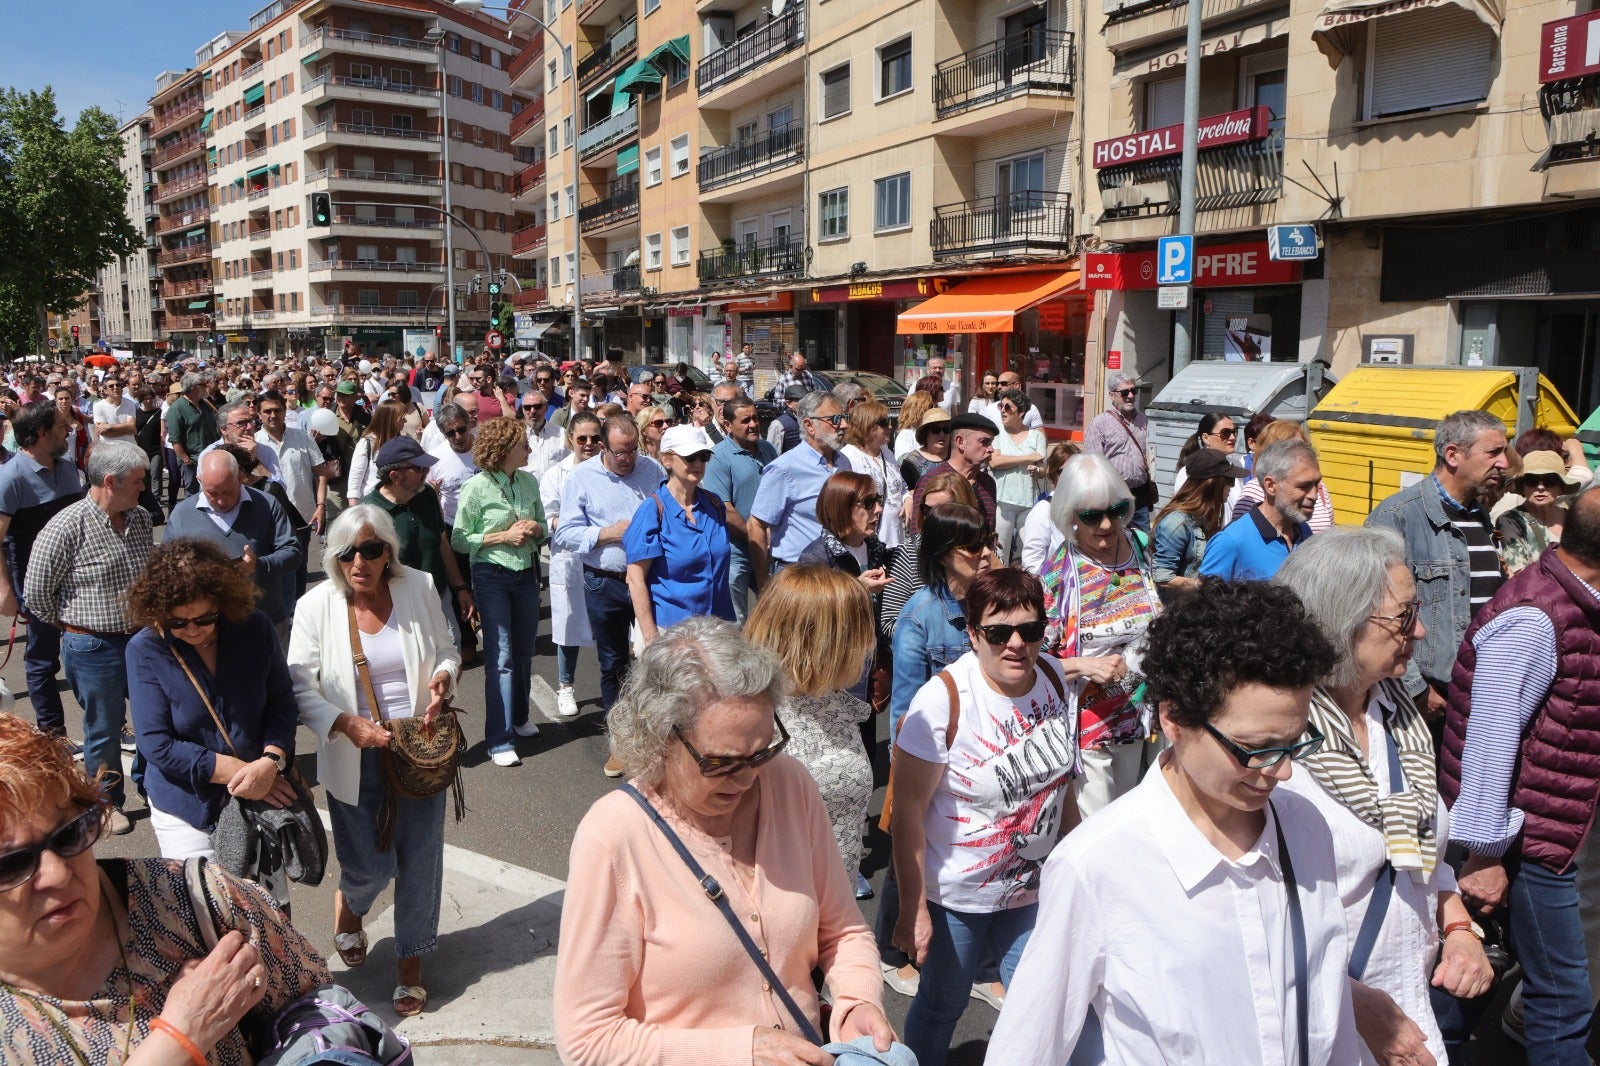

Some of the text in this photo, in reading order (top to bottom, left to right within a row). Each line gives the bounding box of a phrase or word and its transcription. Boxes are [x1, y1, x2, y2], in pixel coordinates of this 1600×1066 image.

[1323, 0, 1441, 26] BARCELON
[1548, 26, 1568, 74] Barcelona
[1097, 116, 1251, 163] HOSTAL rcelona
[1165, 242, 1185, 278] P
[1281, 246, 1314, 256] TELEBANCO
[1195, 252, 1257, 277] PFRE
[849, 283, 882, 296] TABACOS
[919, 321, 937, 331] ÓPTICA
[979, 320, 987, 329] 26
